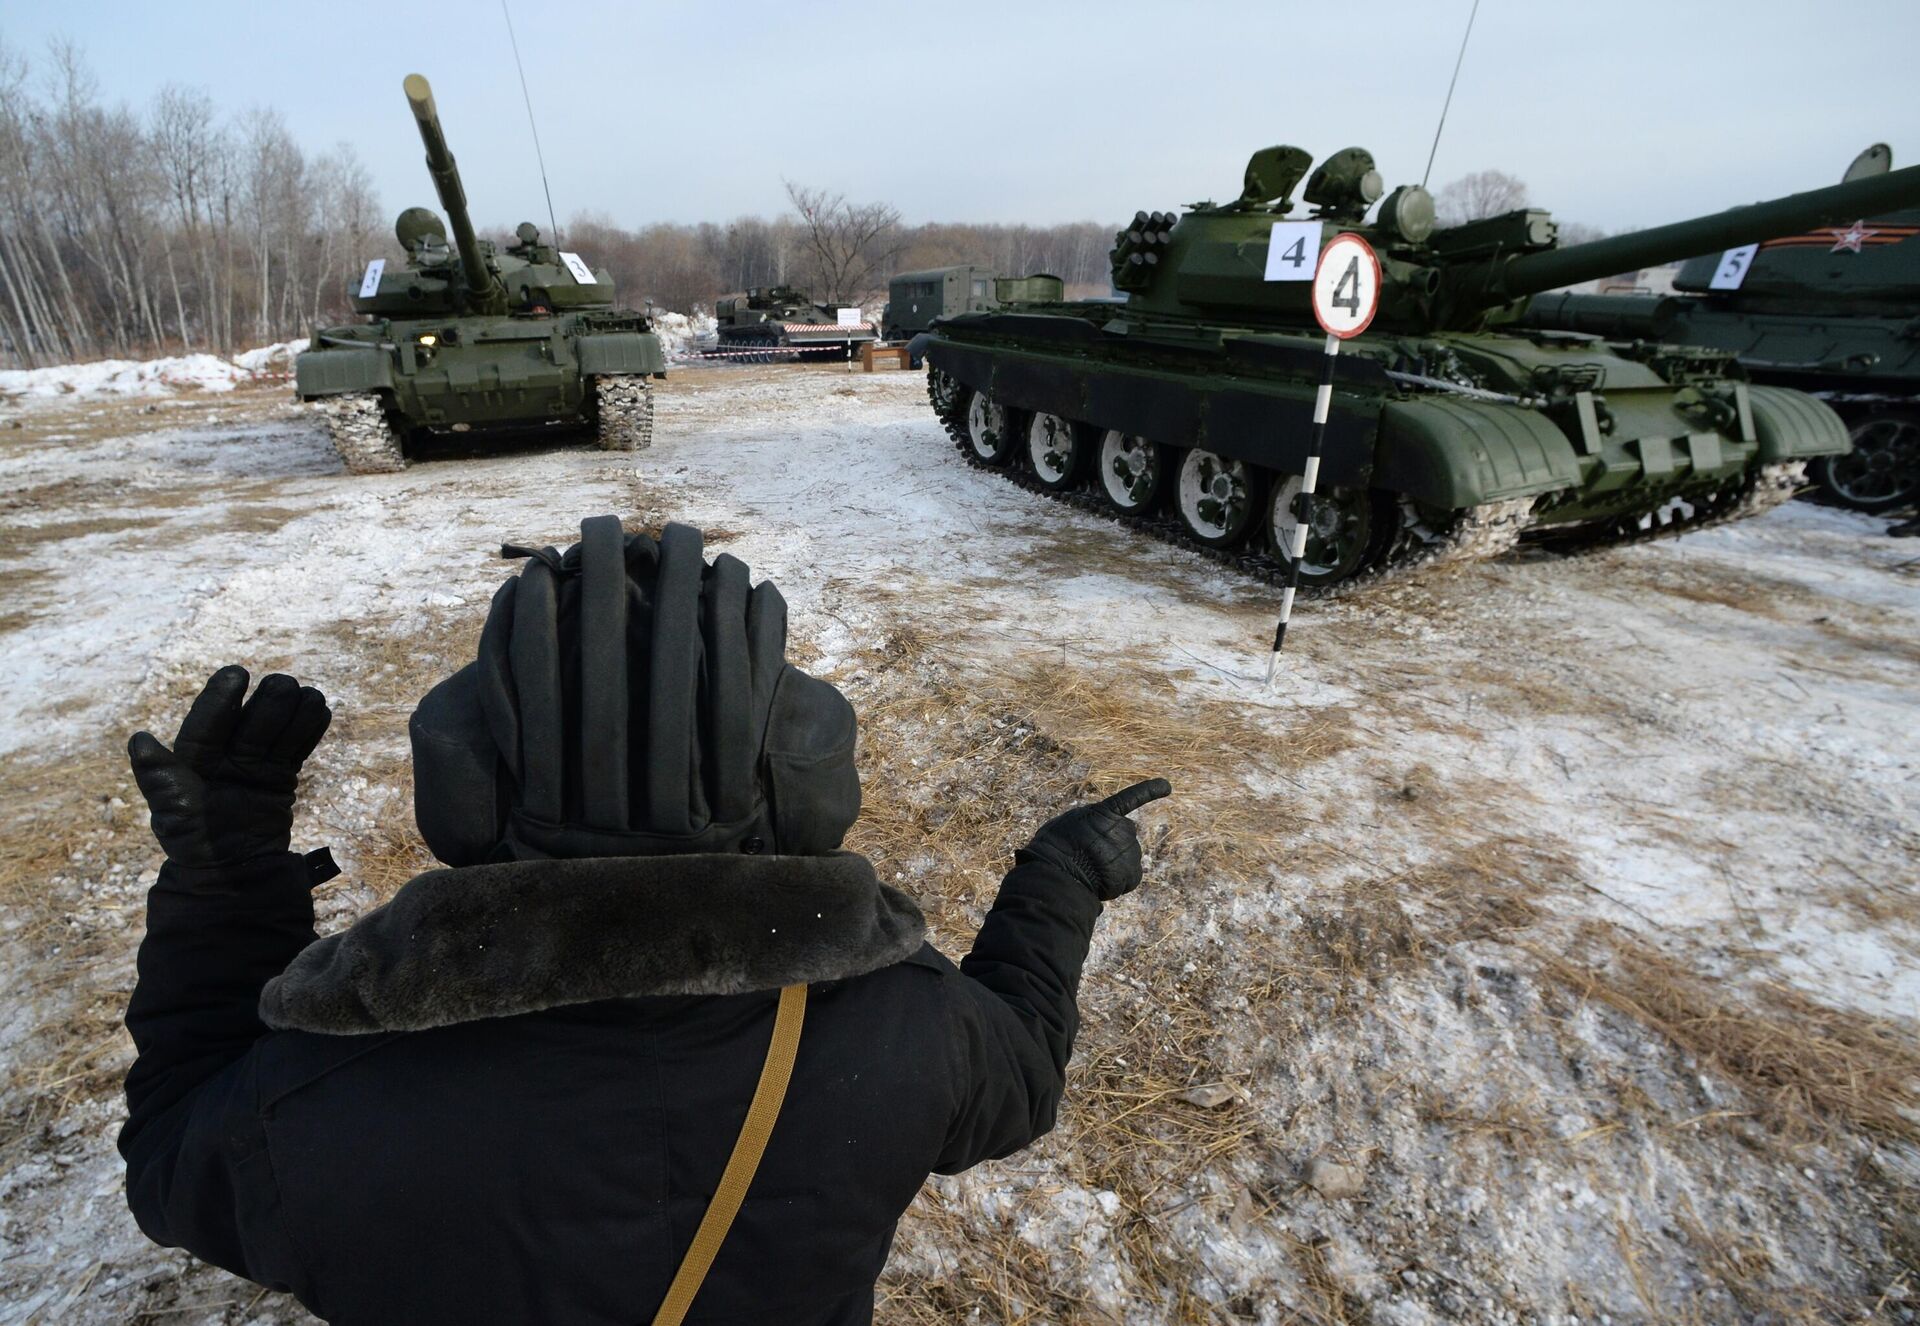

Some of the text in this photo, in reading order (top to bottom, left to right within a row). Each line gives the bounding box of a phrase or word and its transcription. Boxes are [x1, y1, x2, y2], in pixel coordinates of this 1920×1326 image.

[1281, 236, 1306, 267] 4
[1724, 252, 1746, 278] 5
[571, 261, 586, 278] 3
[1332, 256, 1360, 317] 4
